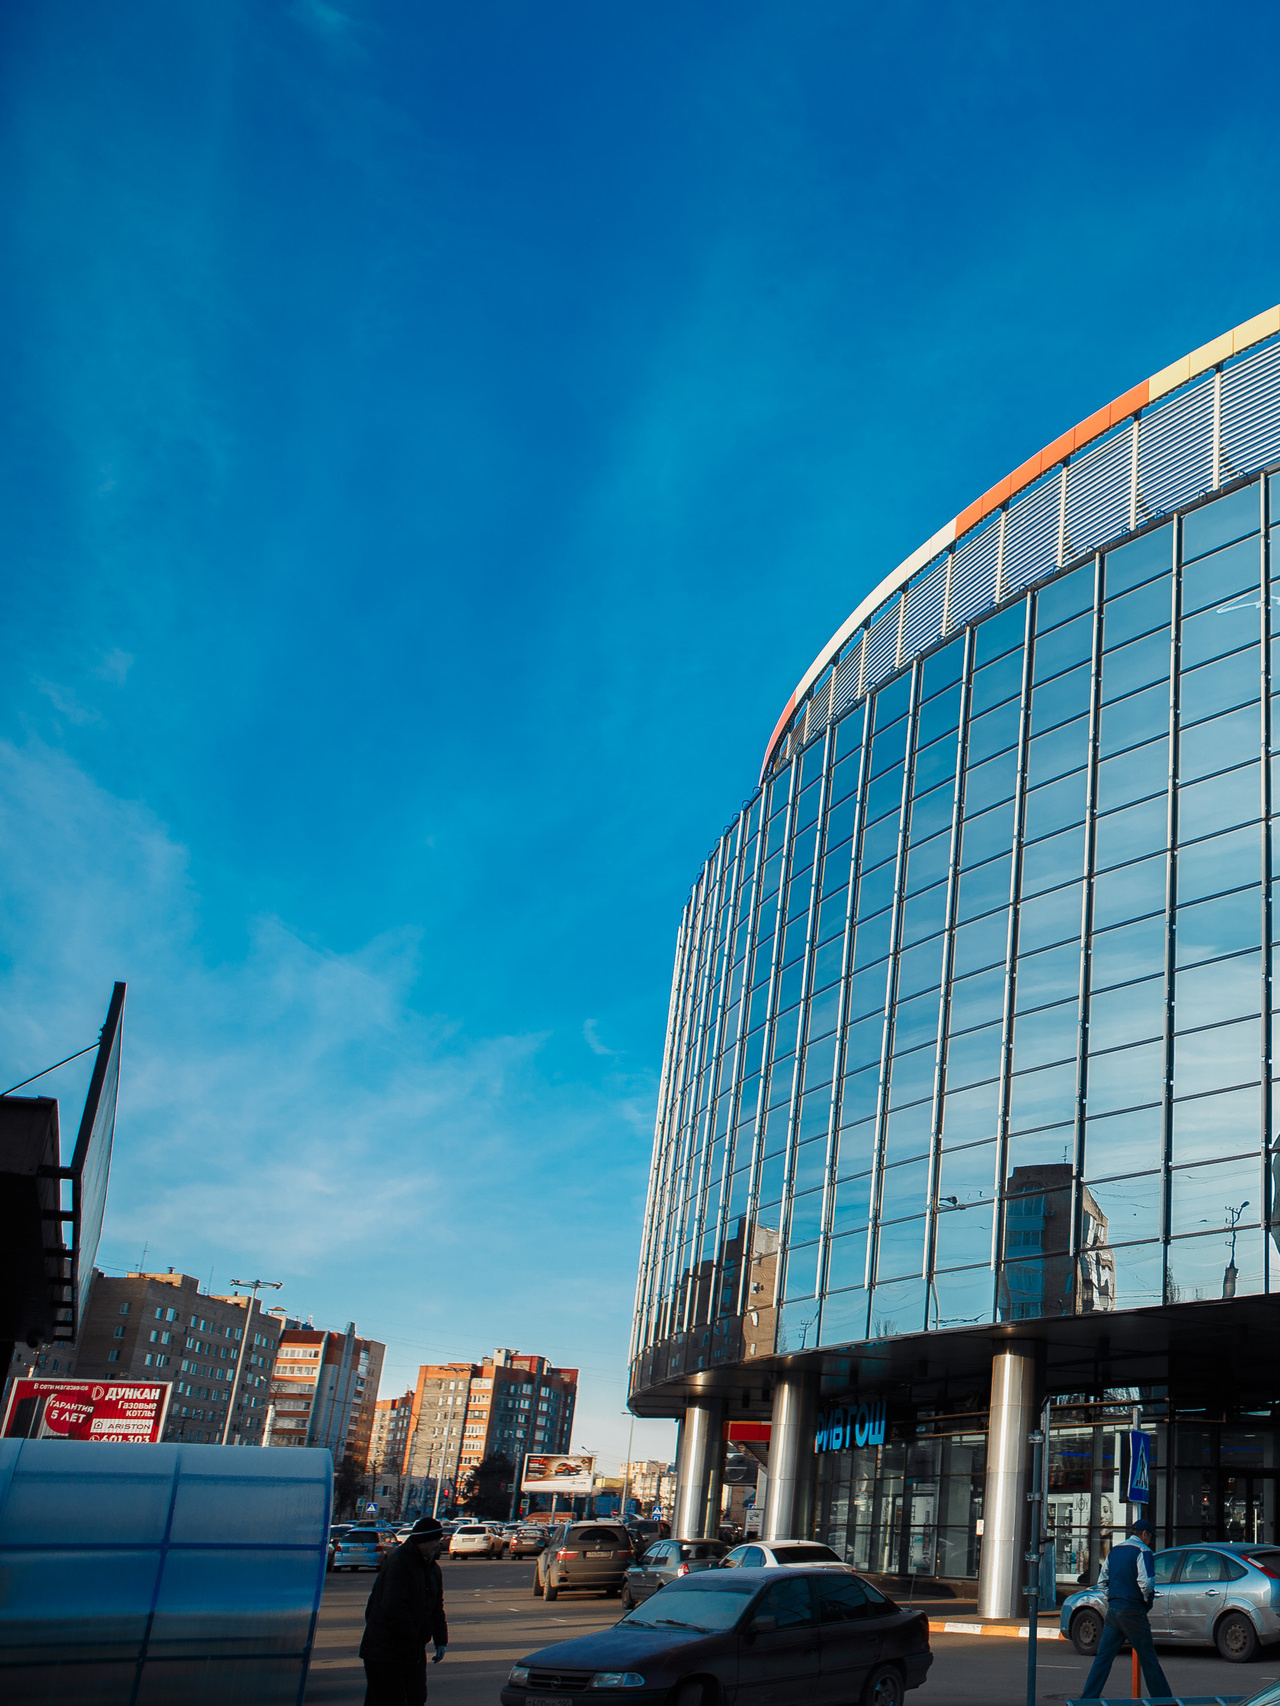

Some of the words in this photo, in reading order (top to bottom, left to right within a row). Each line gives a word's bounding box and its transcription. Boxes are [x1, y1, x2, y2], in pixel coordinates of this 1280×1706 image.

[105, 1387, 161, 1401] ДУНКАН
[50, 1400, 94, 1413] ГАРАНТИЯ
[118, 1400, 157, 1410] Газовые
[50, 1410, 58, 1419] 5
[60, 1412, 86, 1424] ЛЕТ
[126, 1410, 155, 1418] котлы
